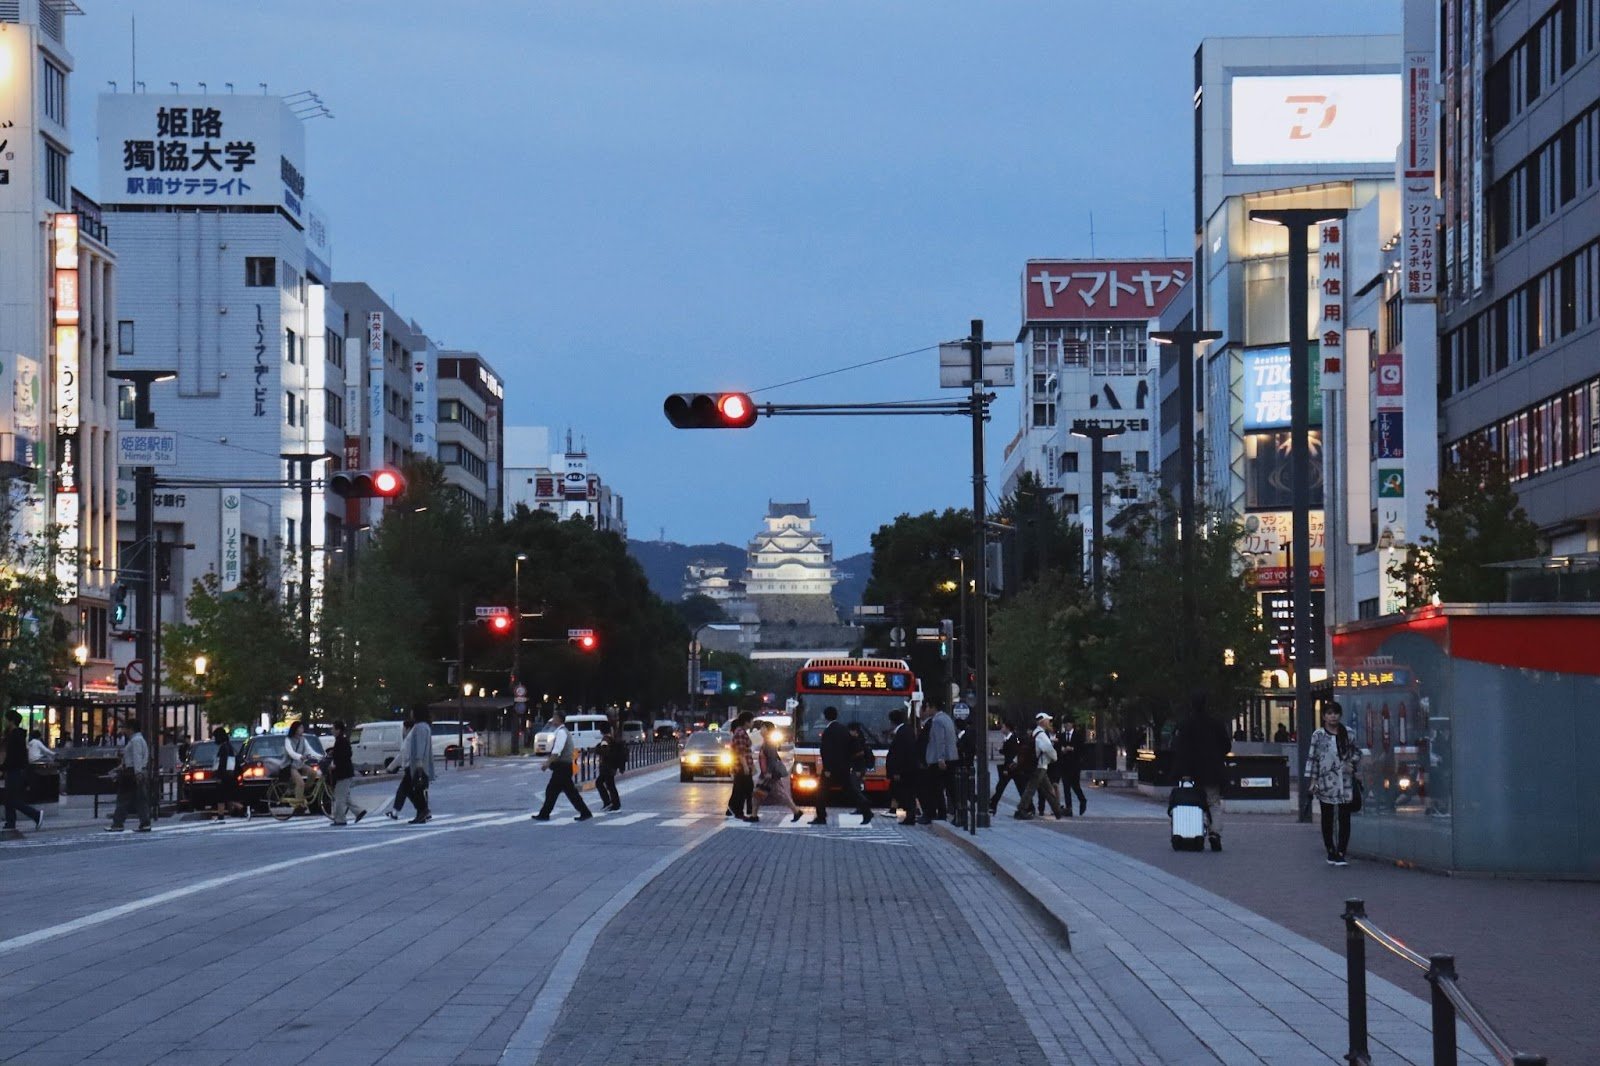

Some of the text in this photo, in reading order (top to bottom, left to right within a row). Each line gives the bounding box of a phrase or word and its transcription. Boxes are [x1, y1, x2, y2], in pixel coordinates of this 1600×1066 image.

[156, 107, 223, 138] 姫路
[123, 140, 256, 172] 獨協大学
[126, 177, 251, 195] 駅前サテライト
[1421, 204, 1433, 292] クリニカルサロン
[1408, 270, 1420, 293] 姫路
[1323, 226, 1341, 374] 播州信用金庫
[372, 313, 382, 351] 共栄火災
[1254, 355, 1291, 365] Aestheti
[414, 382, 425, 443] 第一生命
[121, 436, 174, 451] 姫路駅前
[124, 452, 152, 461] Himeji
[348, 447, 358, 470] 野村
[130, 492, 186, 508] りな銀行
[225, 527, 239, 581] りそな銀行
